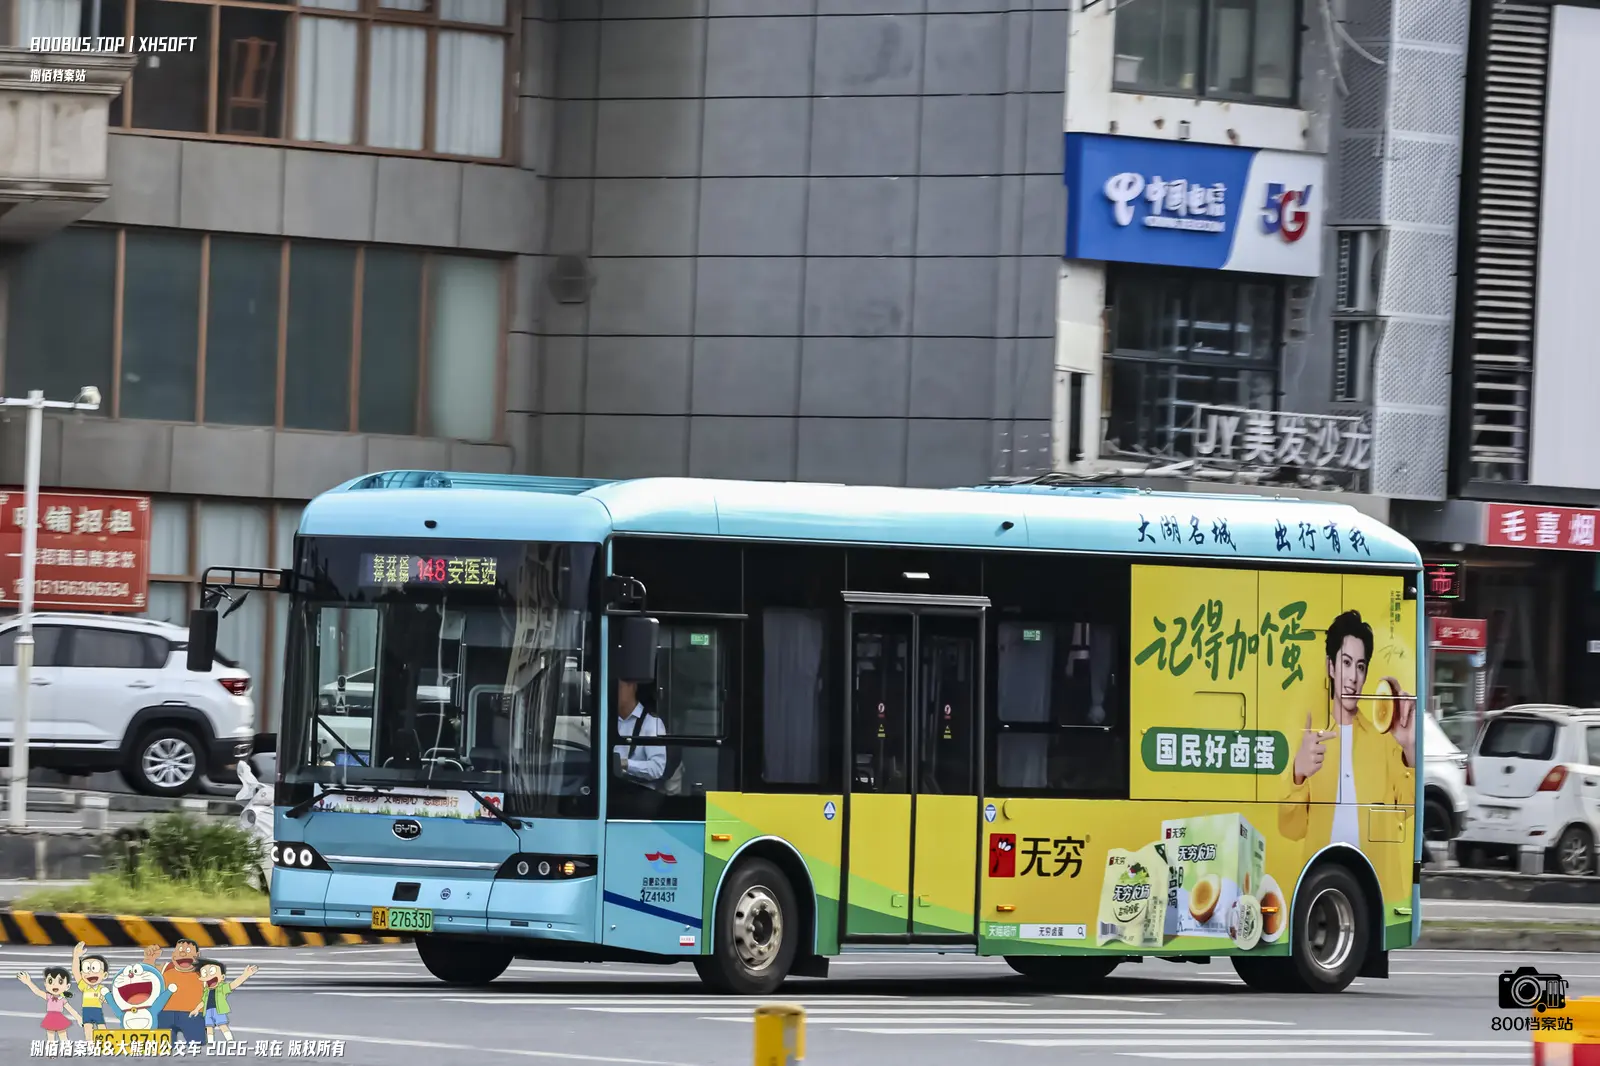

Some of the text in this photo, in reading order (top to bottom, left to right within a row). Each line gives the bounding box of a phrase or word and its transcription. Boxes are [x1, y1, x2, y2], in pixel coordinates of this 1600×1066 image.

[1145, 175, 1227, 217] 中国电信
[1260, 182, 1313, 243] 5G
[1137, 513, 1371, 557] 大湖名城 出行有我
[1500, 509, 1597, 546] 毛喜烟
[417, 556, 497, 586] 148 安医站
[1134, 598, 1317, 691] 记得加个蛋
[1156, 732, 1275, 770] 国民好卤蛋
[394, 824, 419, 834] BYD
[1020, 836, 1085, 878] 无穷
